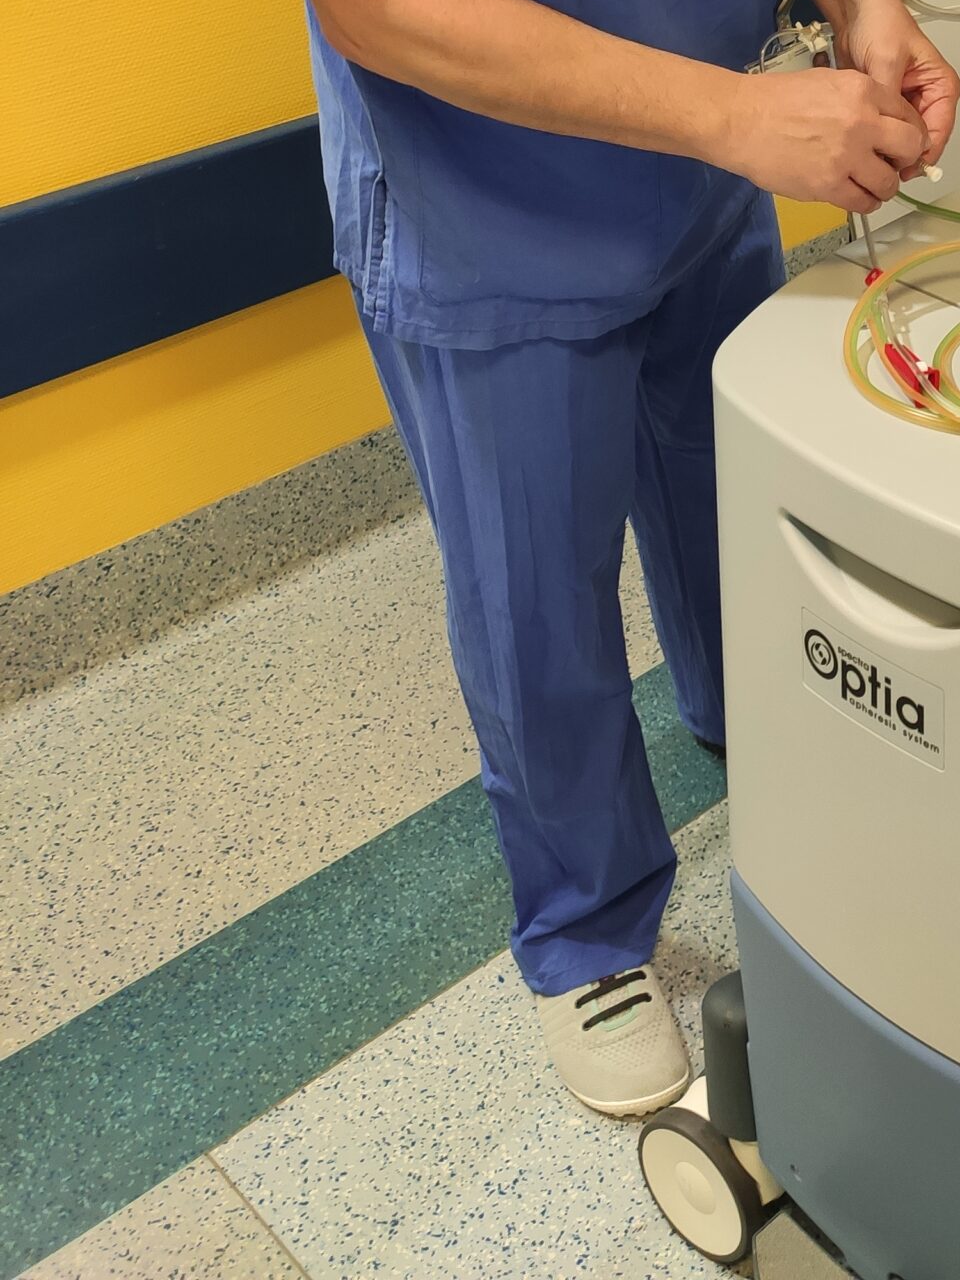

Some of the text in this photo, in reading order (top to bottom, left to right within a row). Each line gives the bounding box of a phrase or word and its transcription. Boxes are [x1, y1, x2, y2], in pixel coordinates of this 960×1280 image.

[804, 628, 924, 736] Optia
[837, 646, 870, 671] spectra
[849, 697, 940, 754] apheresis system
